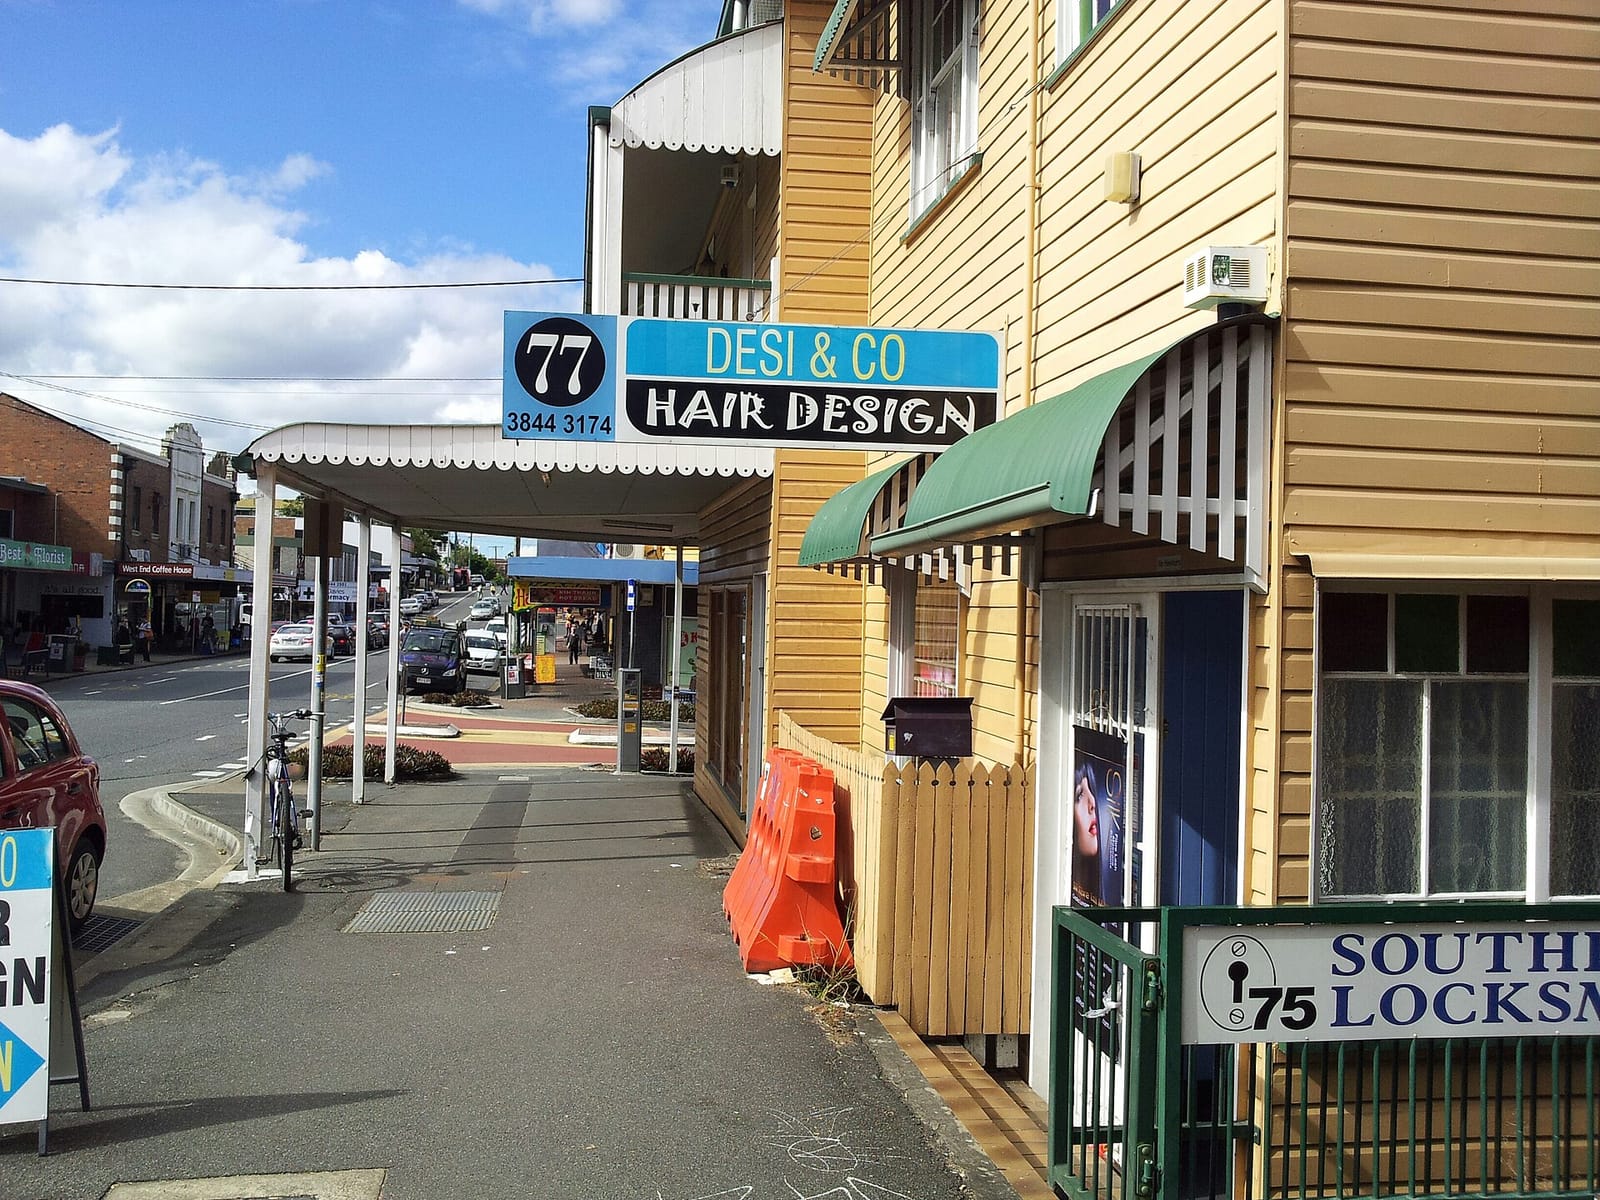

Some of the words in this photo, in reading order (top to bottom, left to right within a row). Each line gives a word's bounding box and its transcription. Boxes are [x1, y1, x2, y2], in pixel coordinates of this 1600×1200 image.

[526, 333, 592, 395] 77
[706, 327, 794, 378] DESI
[809, 331, 837, 379] &
[852, 332, 906, 382] CO
[507, 411, 556, 434] 3844
[562, 414, 612, 435] 3174
[646, 388, 774, 430] HAIR
[786, 393, 976, 435] DESIGN
[34, 546, 65, 567] Florist
[122, 564, 138, 573] West
[139, 565, 150, 573] End
[152, 565, 172, 574] Coffee
[173, 566, 192, 574] House
[1106, 768, 1122, 831] Silk
[0, 956, 47, 1007] N
[1248, 986, 1318, 1031] 75
